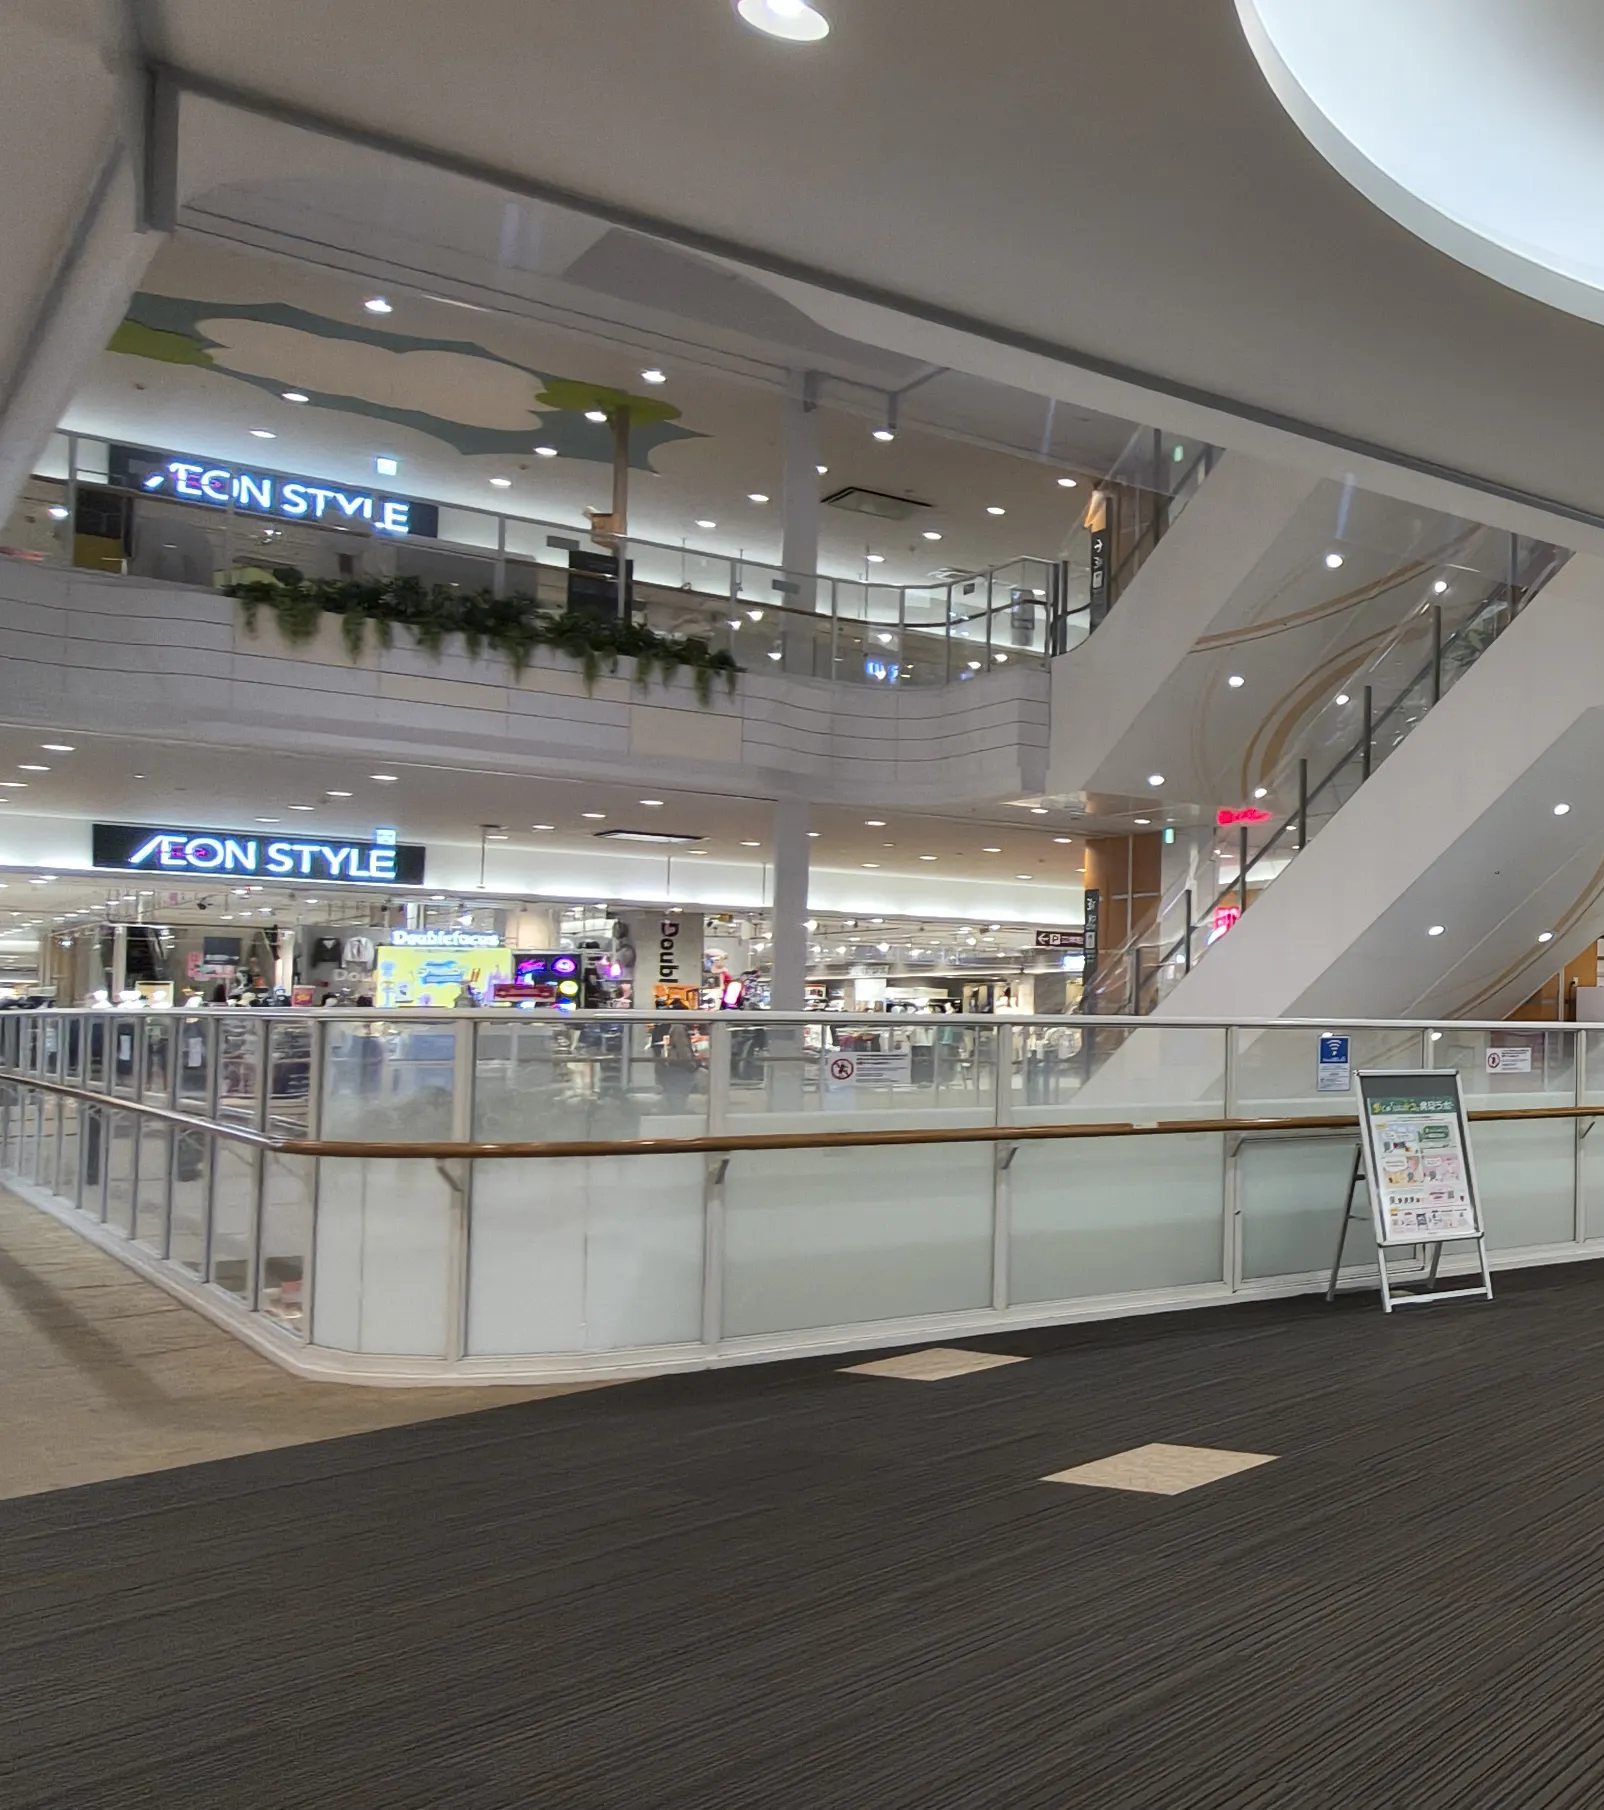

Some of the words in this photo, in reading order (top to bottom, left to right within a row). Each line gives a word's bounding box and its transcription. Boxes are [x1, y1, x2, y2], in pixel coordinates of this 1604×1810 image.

[280, 483, 410, 534] STYLE
[264, 842, 396, 879] STYLE
[391, 930, 500, 946] Doublefocus
